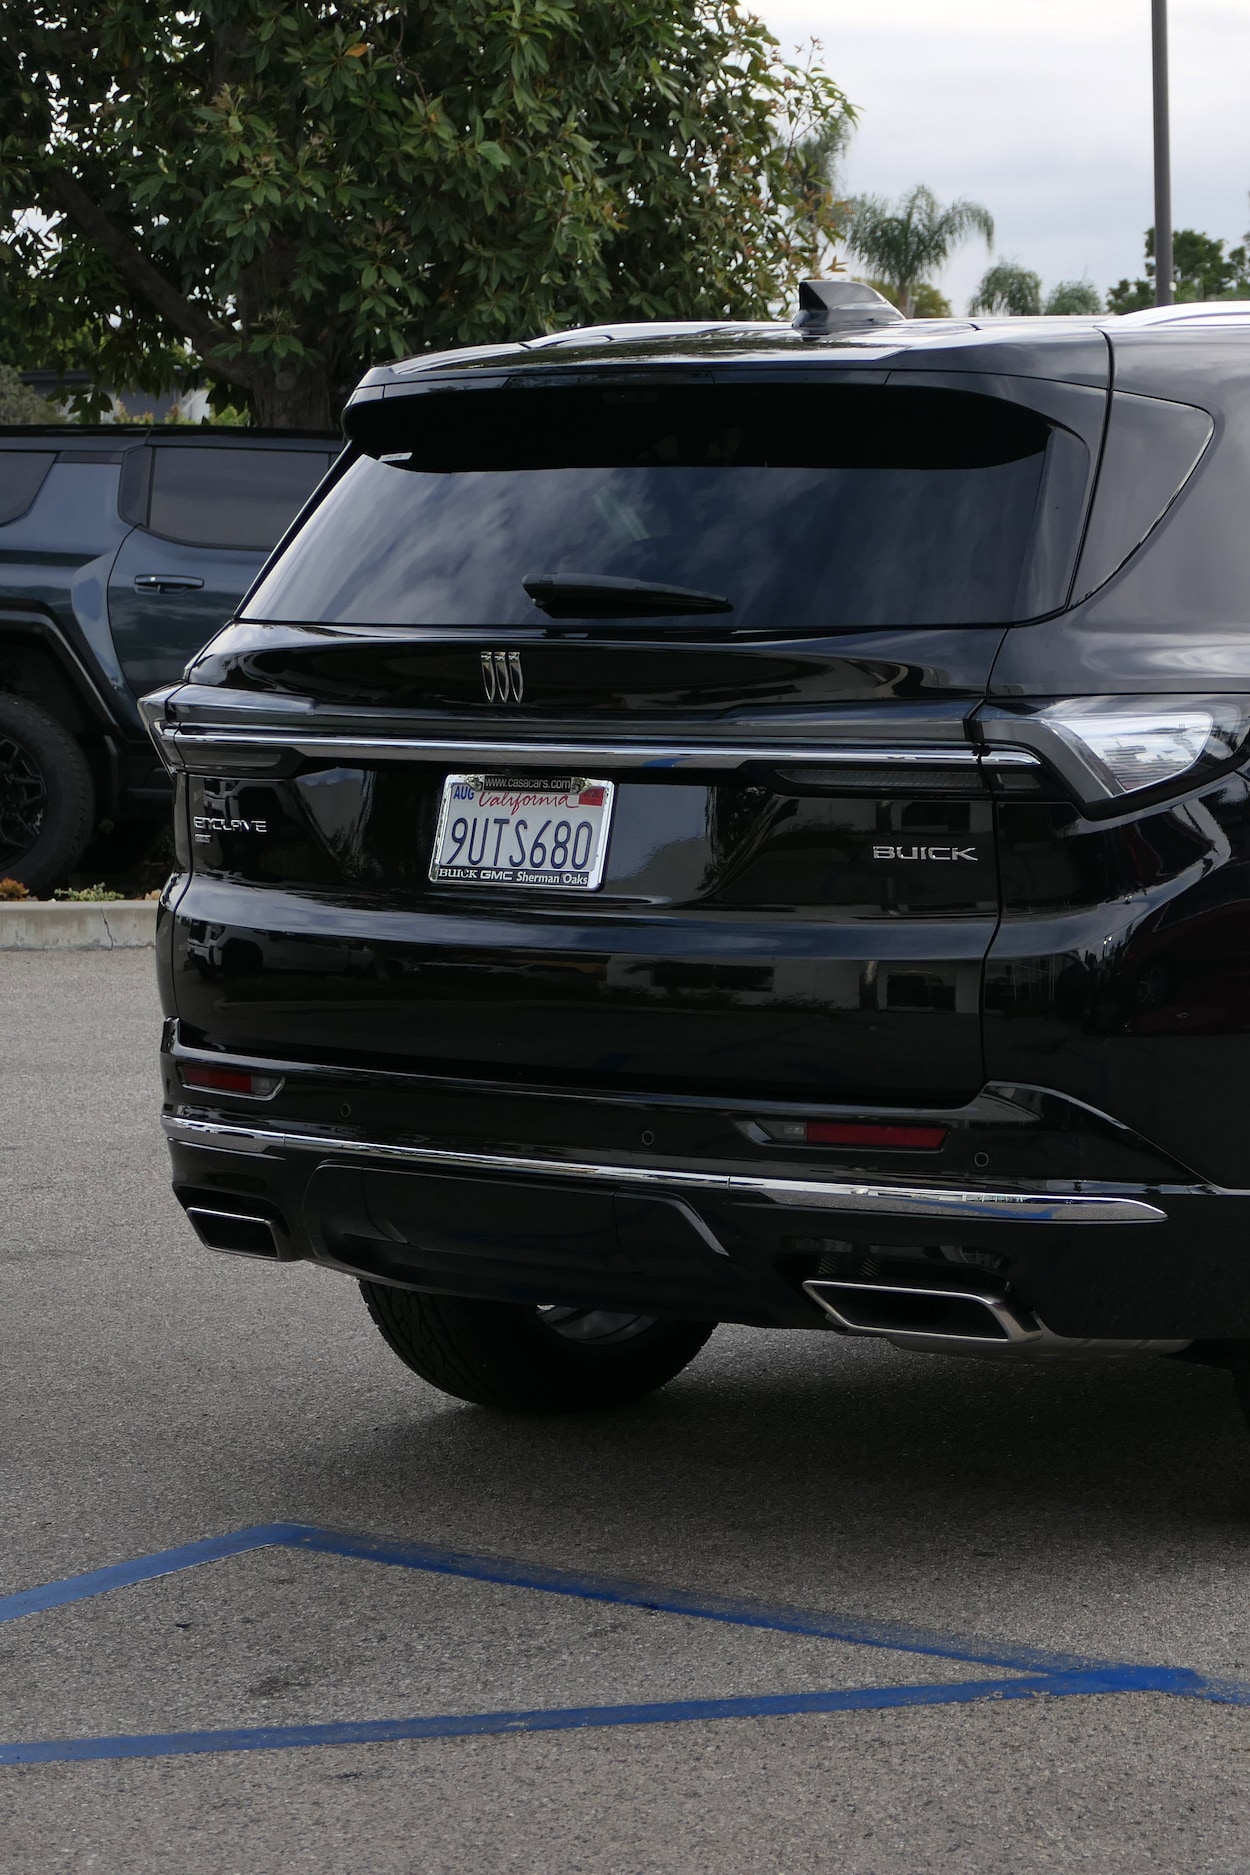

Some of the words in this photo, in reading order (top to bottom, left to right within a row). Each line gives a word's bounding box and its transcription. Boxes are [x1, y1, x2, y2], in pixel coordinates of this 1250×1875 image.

[485, 777, 571, 790] www.casacars.com
[453, 786, 475, 800] AUG
[478, 791, 579, 816] California
[447, 817, 593, 870] 9UTS680
[873, 845, 978, 861] BUICK
[438, 868, 478, 879] BUICK
[480, 870, 514, 881] GMC
[516, 870, 559, 884] Sherman
[563, 873, 588, 885] Oaks
